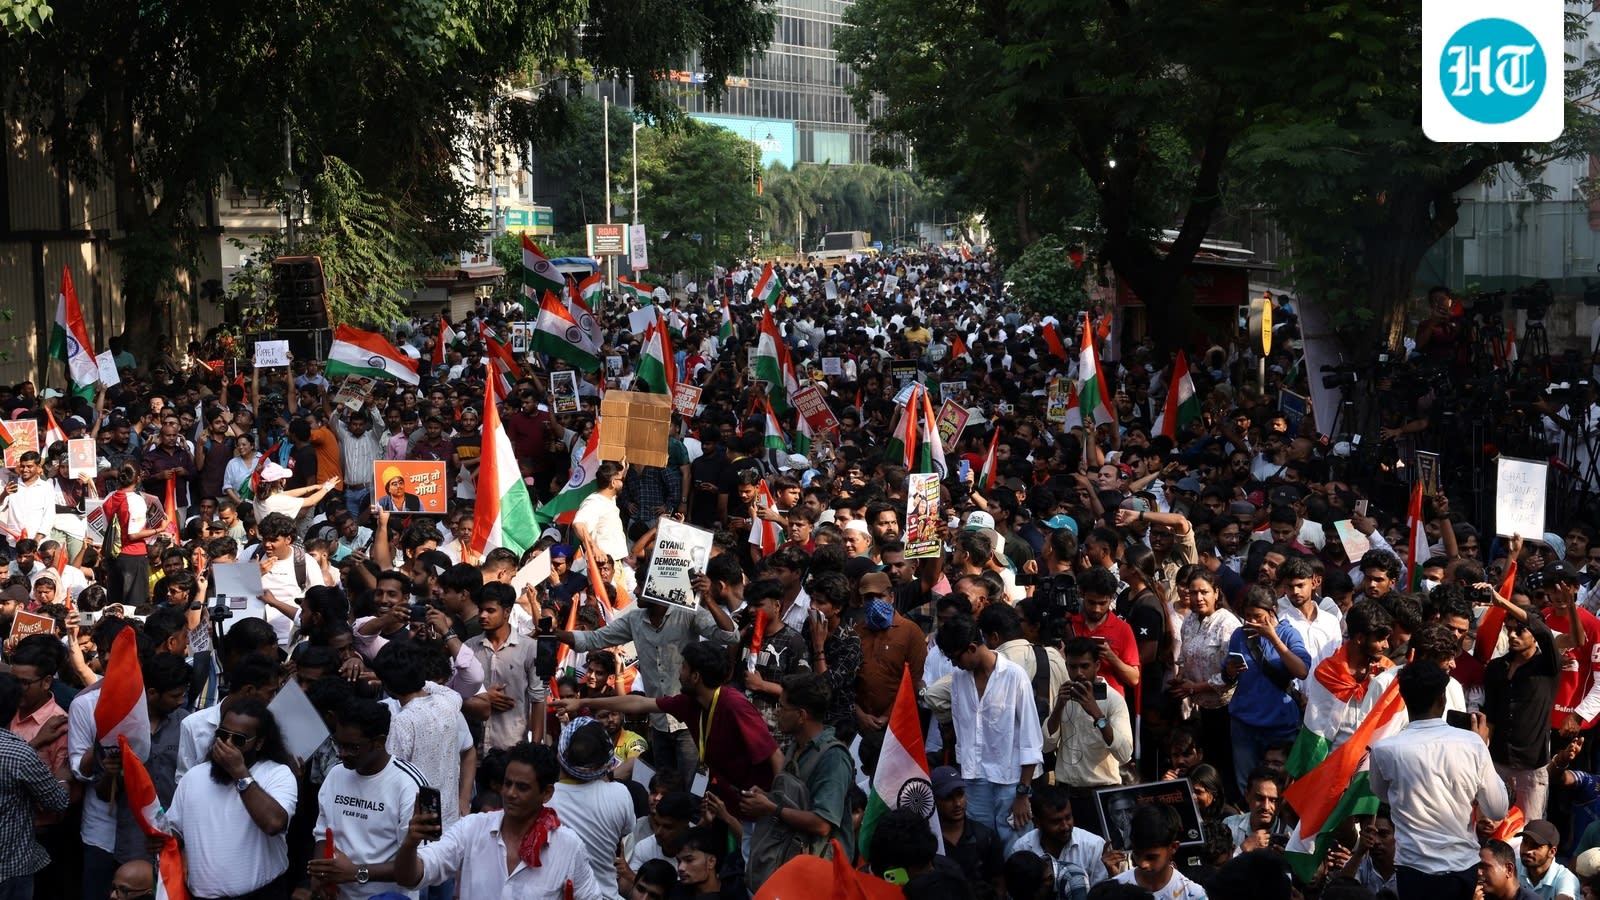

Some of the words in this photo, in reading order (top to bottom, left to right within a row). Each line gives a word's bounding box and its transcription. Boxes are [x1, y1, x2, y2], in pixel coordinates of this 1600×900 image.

[598, 227, 618, 236] ROAR
[256, 344, 274, 357] PUPPET
[654, 557, 691, 567] DEMOCRACY
[335, 794, 385, 811] ESSENTIALS
